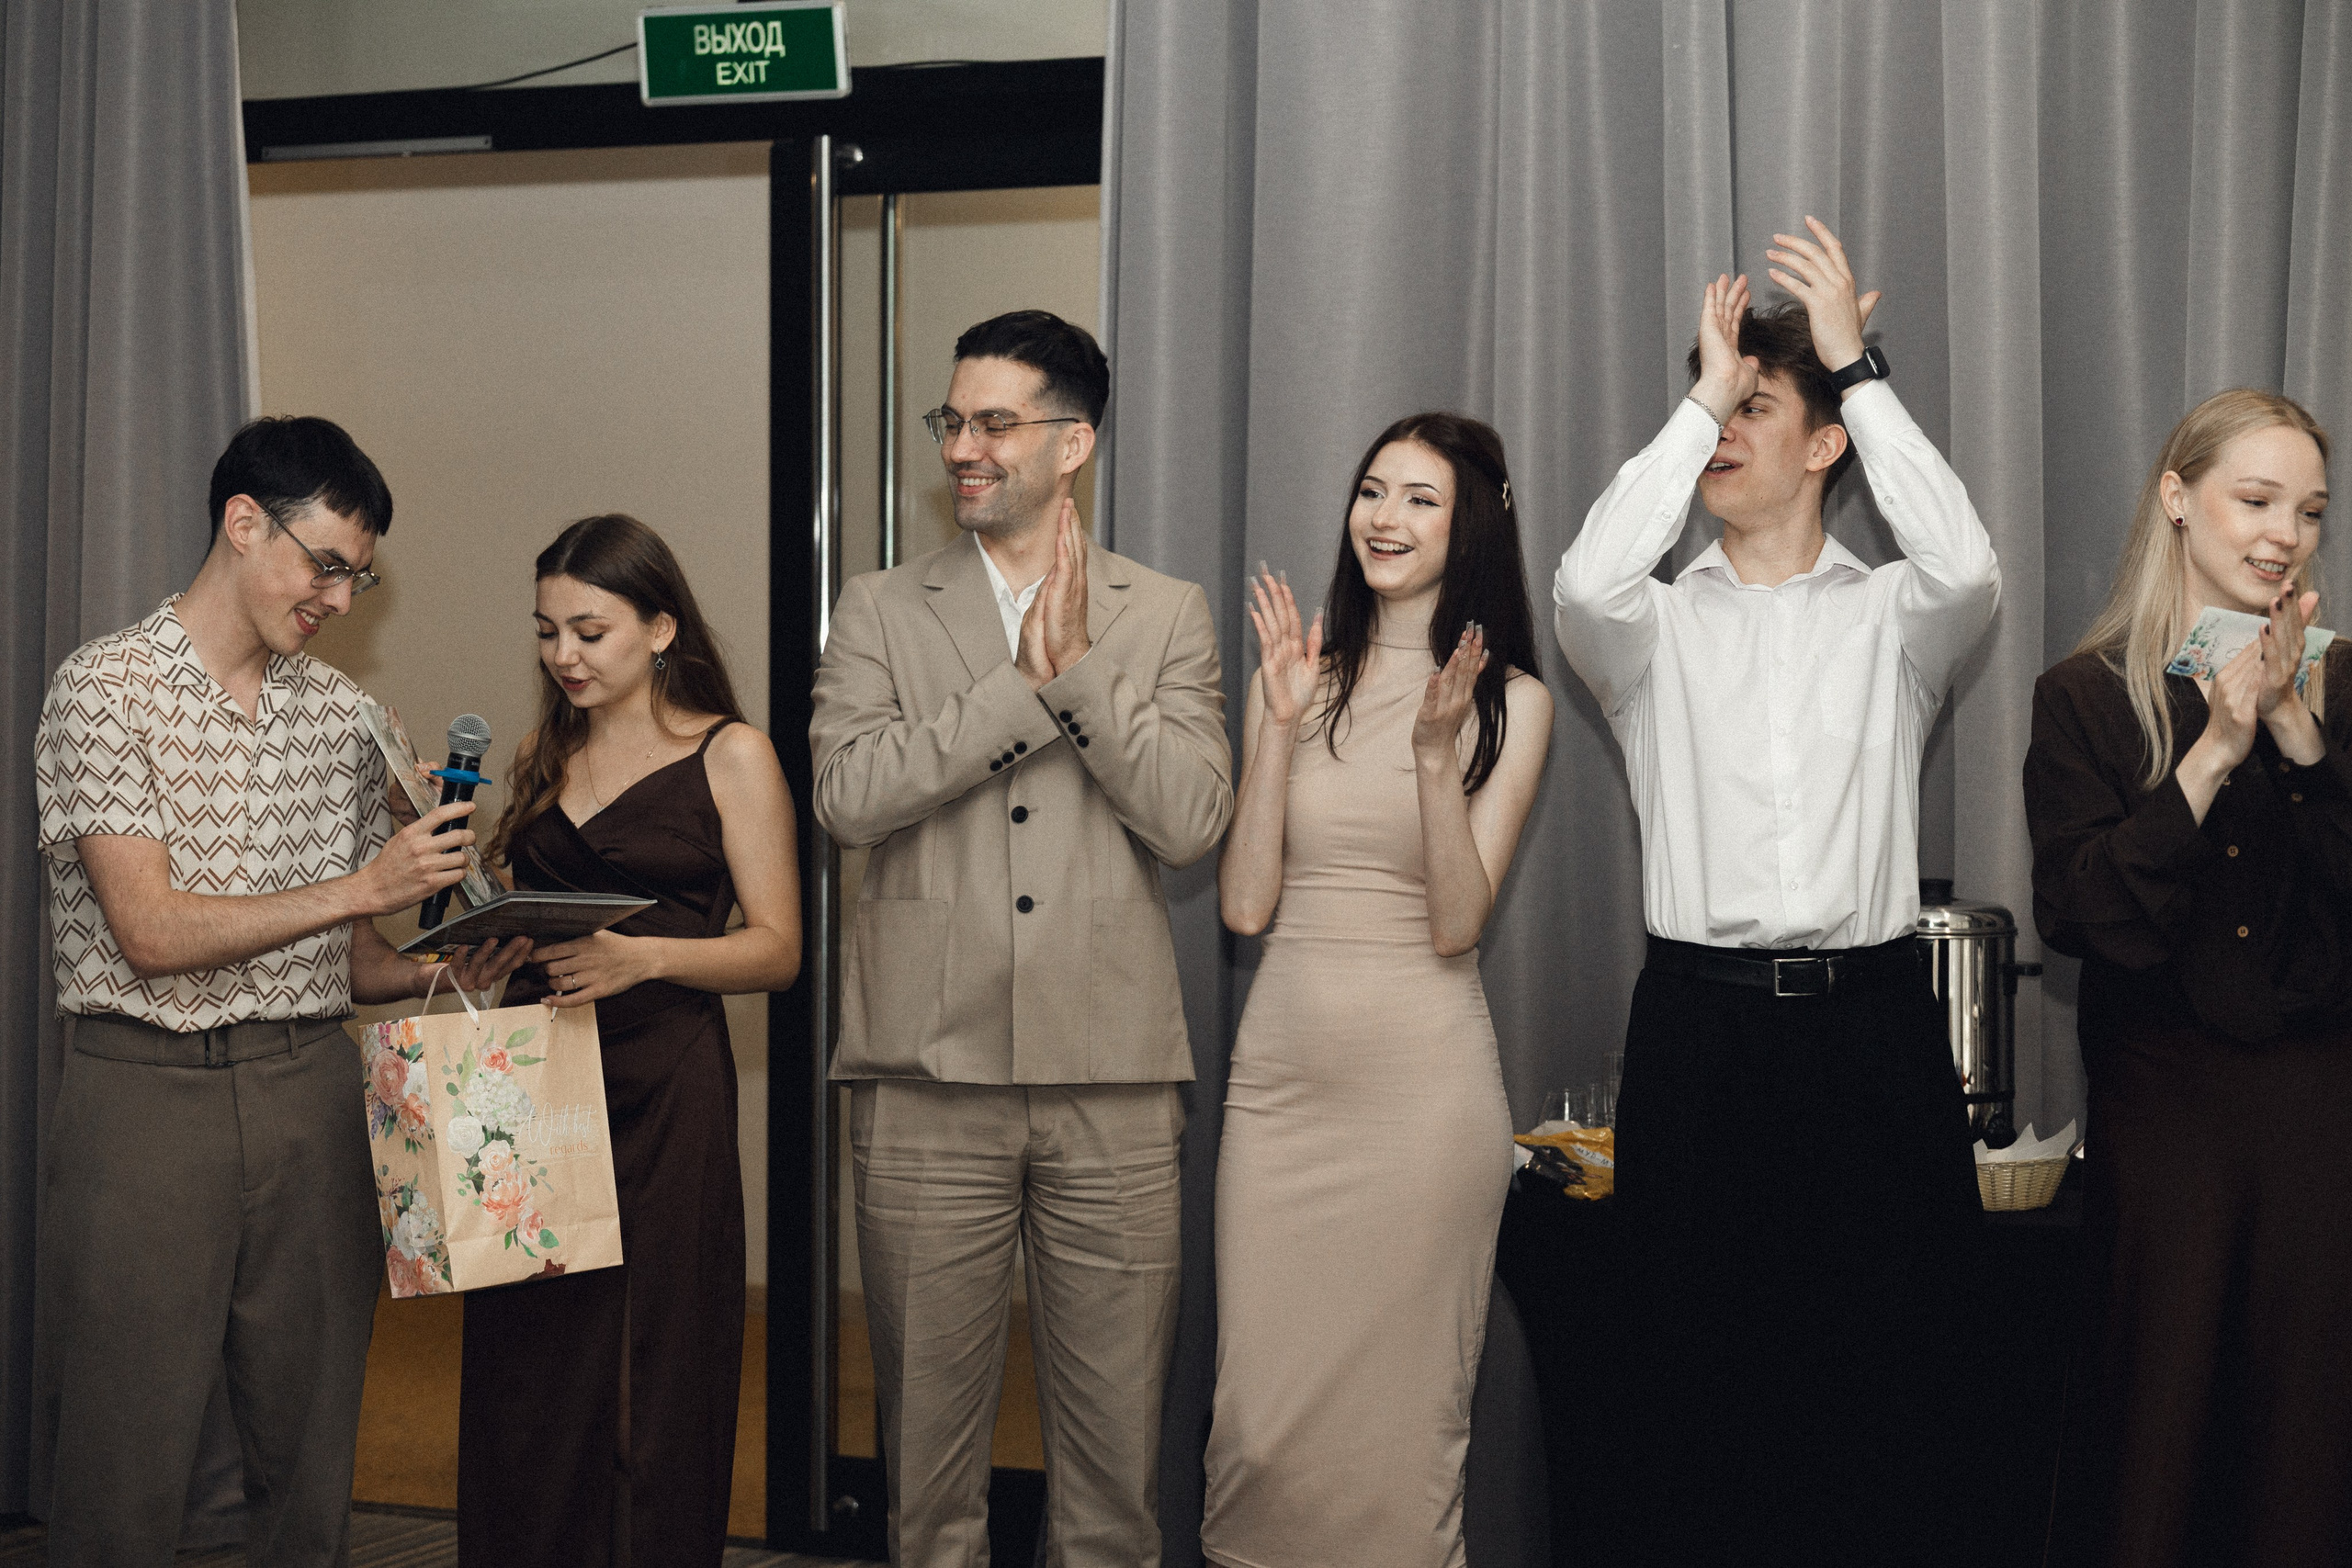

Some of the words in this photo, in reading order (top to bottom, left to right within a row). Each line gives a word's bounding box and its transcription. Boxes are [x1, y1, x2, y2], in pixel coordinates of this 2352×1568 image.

[694, 20, 786, 58] ВЫХОД
[716, 61, 770, 85] EXIT
[518, 1102, 569, 1146] With
[573, 1104, 597, 1138] best
[549, 1139, 589, 1156] regards
